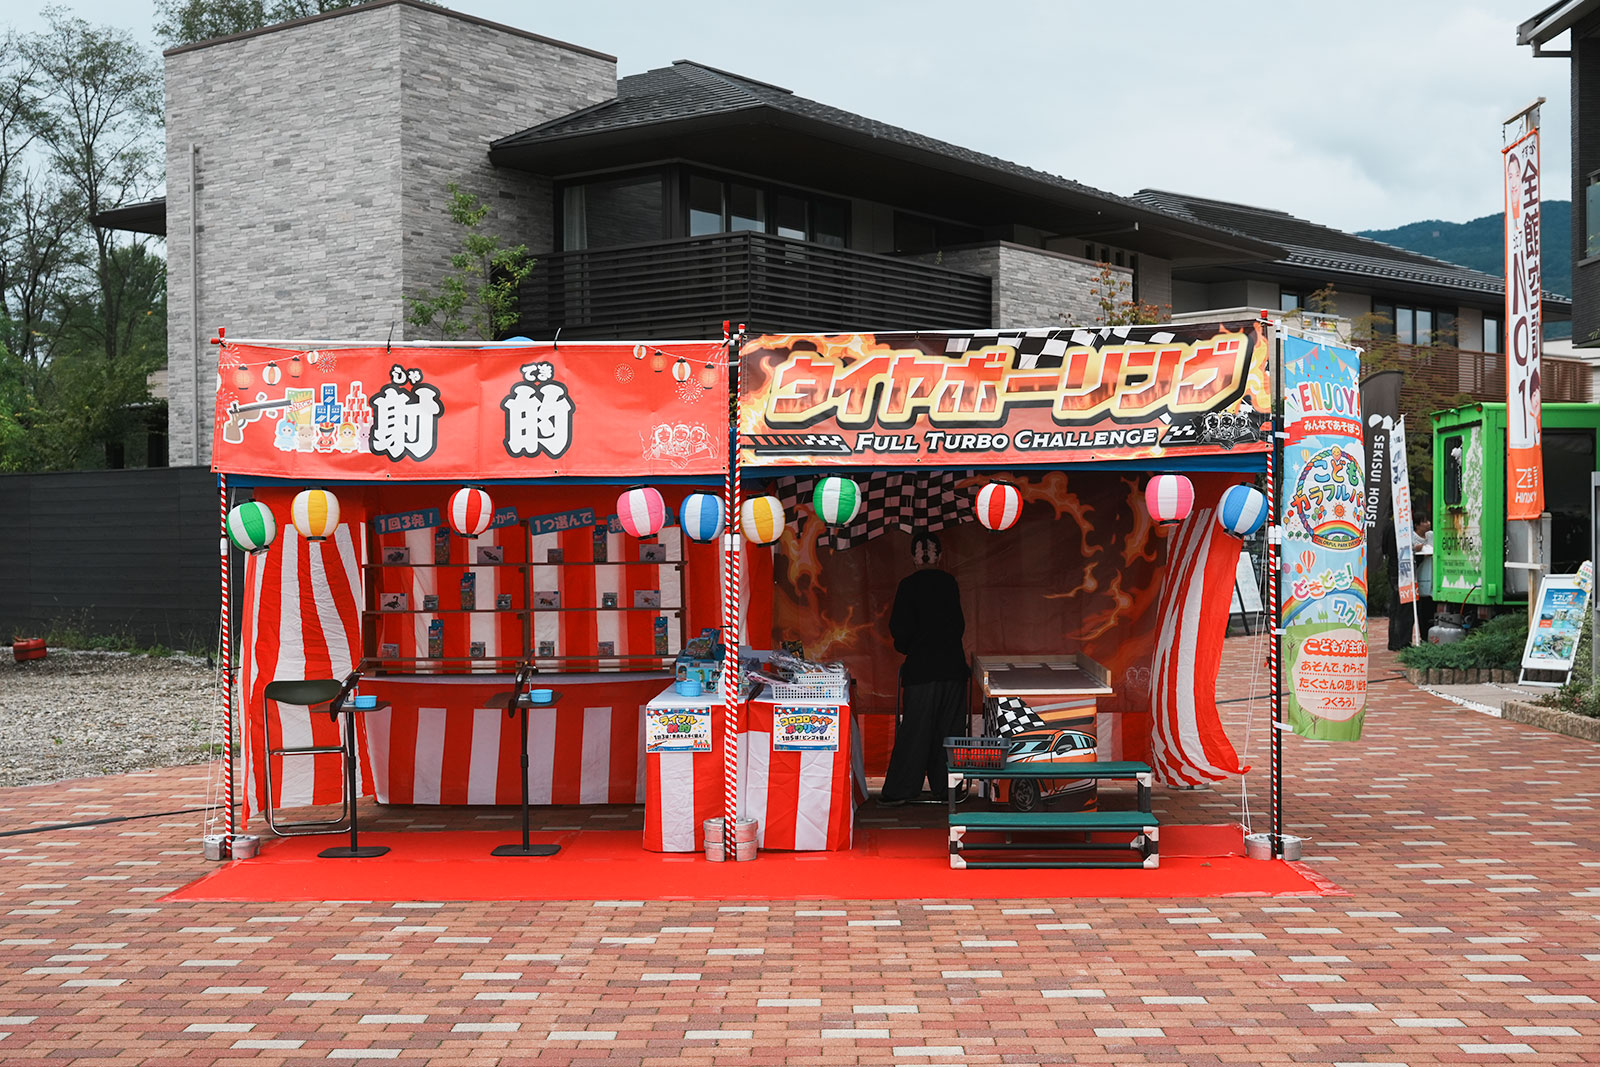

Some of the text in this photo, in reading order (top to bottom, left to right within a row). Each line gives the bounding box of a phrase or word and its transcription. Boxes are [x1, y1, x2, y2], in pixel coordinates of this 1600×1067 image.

[773, 336, 1244, 417] タイヤボーリング
[1299, 383, 1360, 418] ENJOY!
[855, 428, 1158, 453] FULL TURBO CHALLENGE
[1314, 459, 1359, 486] こども
[1366, 434, 1385, 528] SEKISUI HOUSE
[1291, 484, 1366, 514] カラフルパ
[1294, 564, 1353, 600] どきどき!
[659, 714, 697, 726] ライフル
[780, 715, 833, 727] コロコロタイヤ
